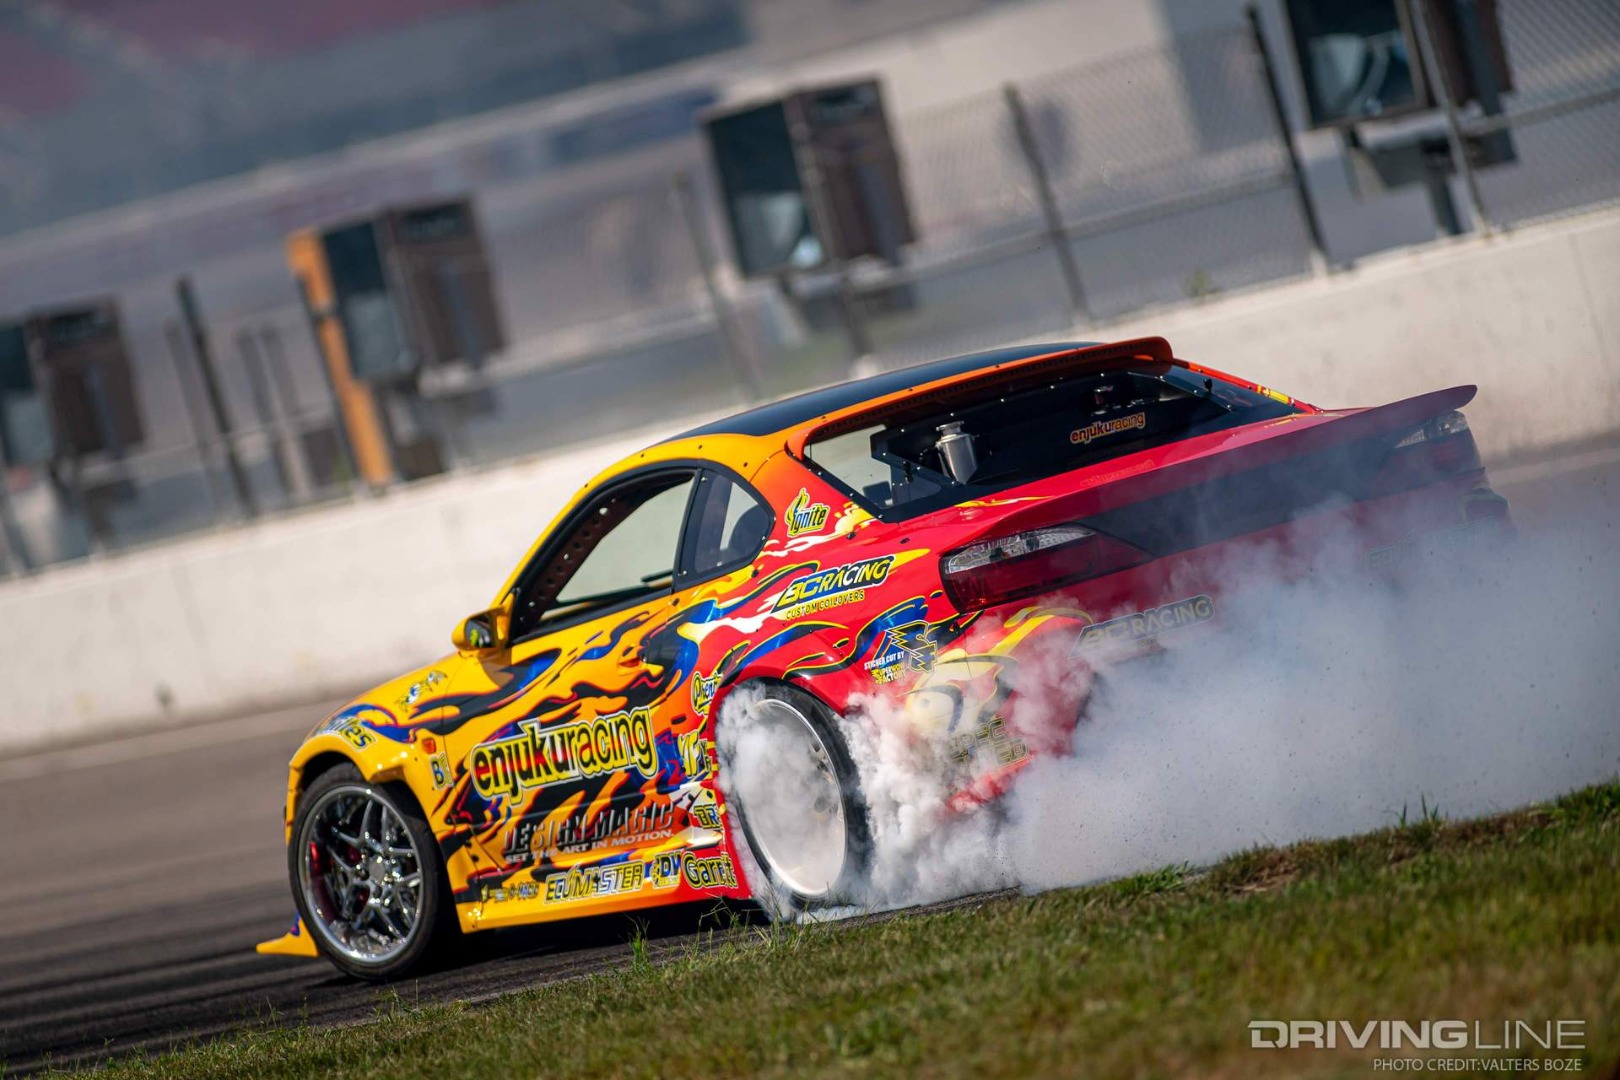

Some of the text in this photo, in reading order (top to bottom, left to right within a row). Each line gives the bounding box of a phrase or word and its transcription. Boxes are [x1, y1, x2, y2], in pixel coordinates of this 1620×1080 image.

[1071, 413, 1144, 442] enjukuracing
[786, 591, 864, 619] CUSTOM COILOVERS
[473, 711, 653, 797] enjukuracing
[562, 843, 589, 854] ART
[591, 840, 607, 850] IN
[546, 864, 642, 902] ECUMASTER
